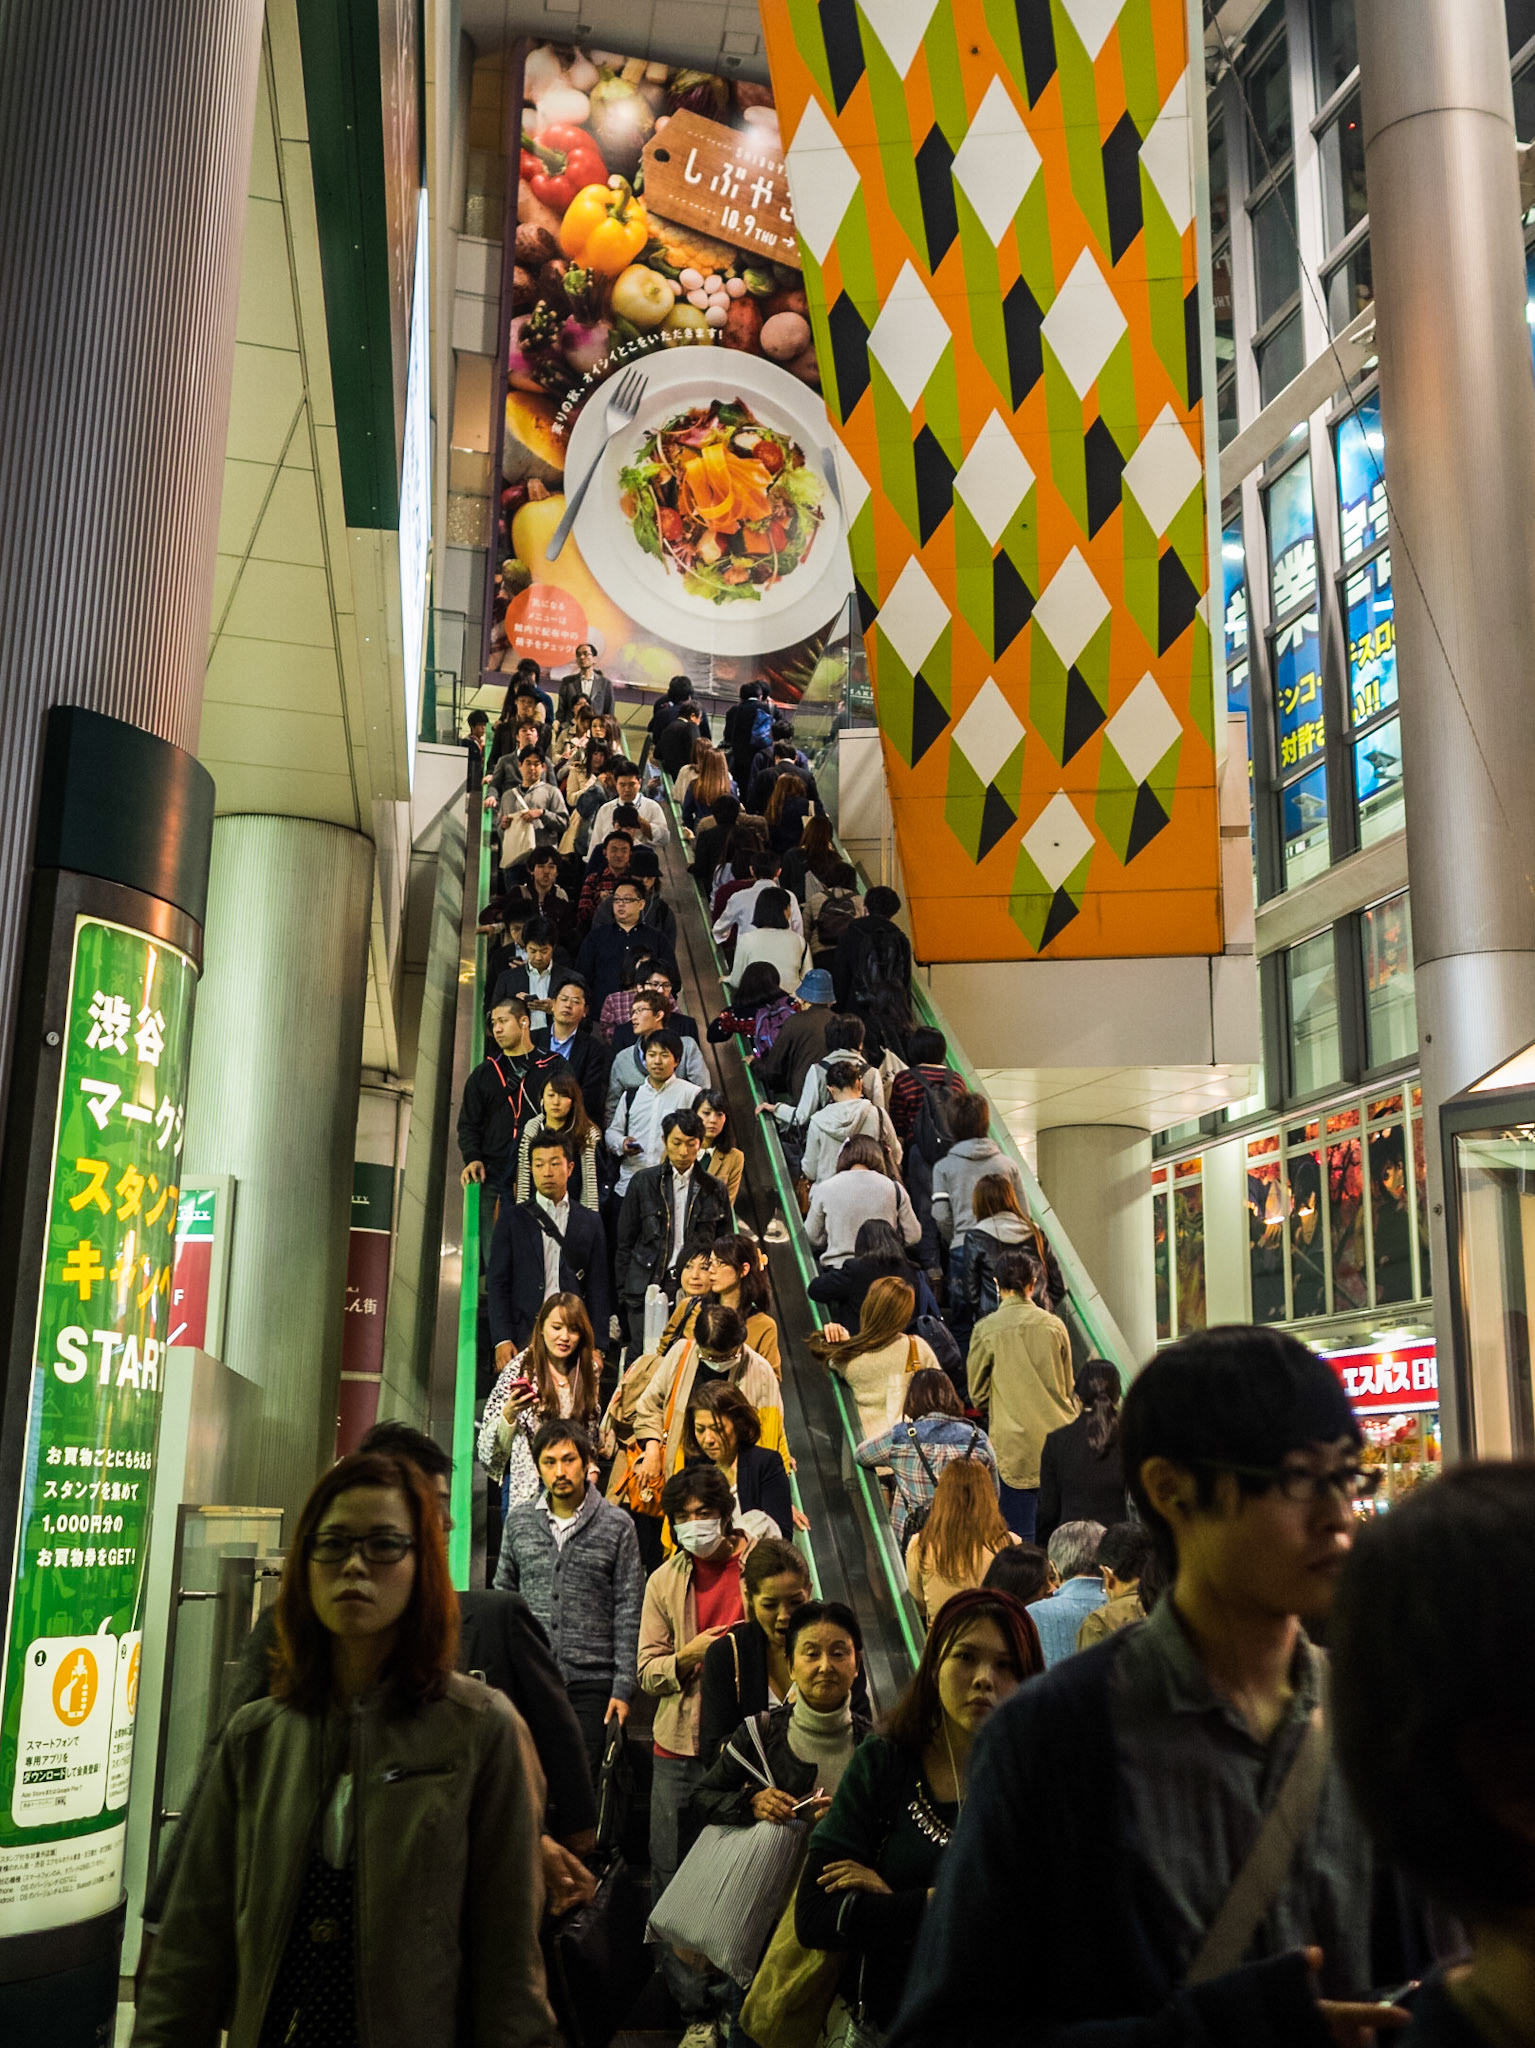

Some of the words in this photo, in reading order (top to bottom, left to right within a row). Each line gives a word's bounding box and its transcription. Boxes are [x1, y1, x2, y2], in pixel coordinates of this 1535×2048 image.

[735, 147, 788, 178] SHIBUY
[85, 990, 166, 1067] 渋谷
[344, 1298, 378, 1315] ん街
[46, 1446, 152, 1469] お買物ごとにもらえる
[43, 1481, 139, 1501] スタンプを集めて
[42, 1514, 123, 1534] 1,000円分の
[36, 1548, 136, 1567] お買物券をGET!
[26, 1736, 80, 1751] スマートフォンで
[25, 1753, 69, 1767] 専用アプリを
